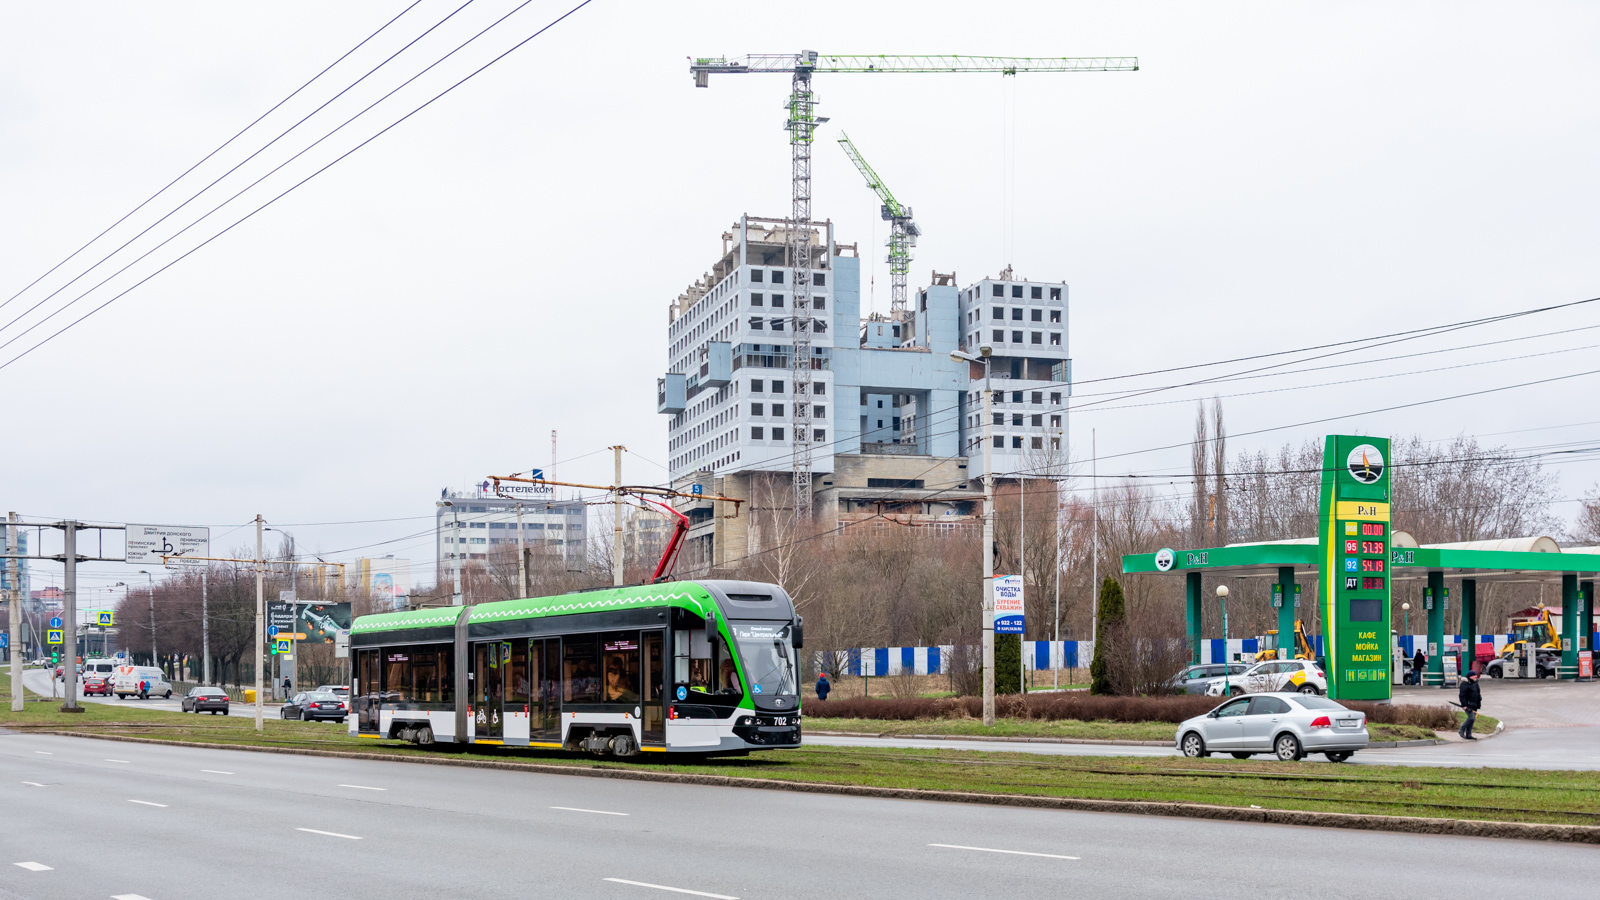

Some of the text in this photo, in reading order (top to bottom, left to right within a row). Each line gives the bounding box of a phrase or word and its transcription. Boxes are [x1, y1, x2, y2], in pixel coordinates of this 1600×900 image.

[1358, 506, 1376, 516] P&H
[1362, 524, 1384, 536] 00.00
[1346, 542, 1357, 552] 95
[1187, 552, 1208, 565] P&H
[1391, 551, 1414, 564] P&H
[1346, 560, 1384, 572] 92 54.19
[1346, 578, 1357, 588] ДТ
[1356, 642, 1378, 650] МОЙКА
[774, 716, 787, 725] 702
